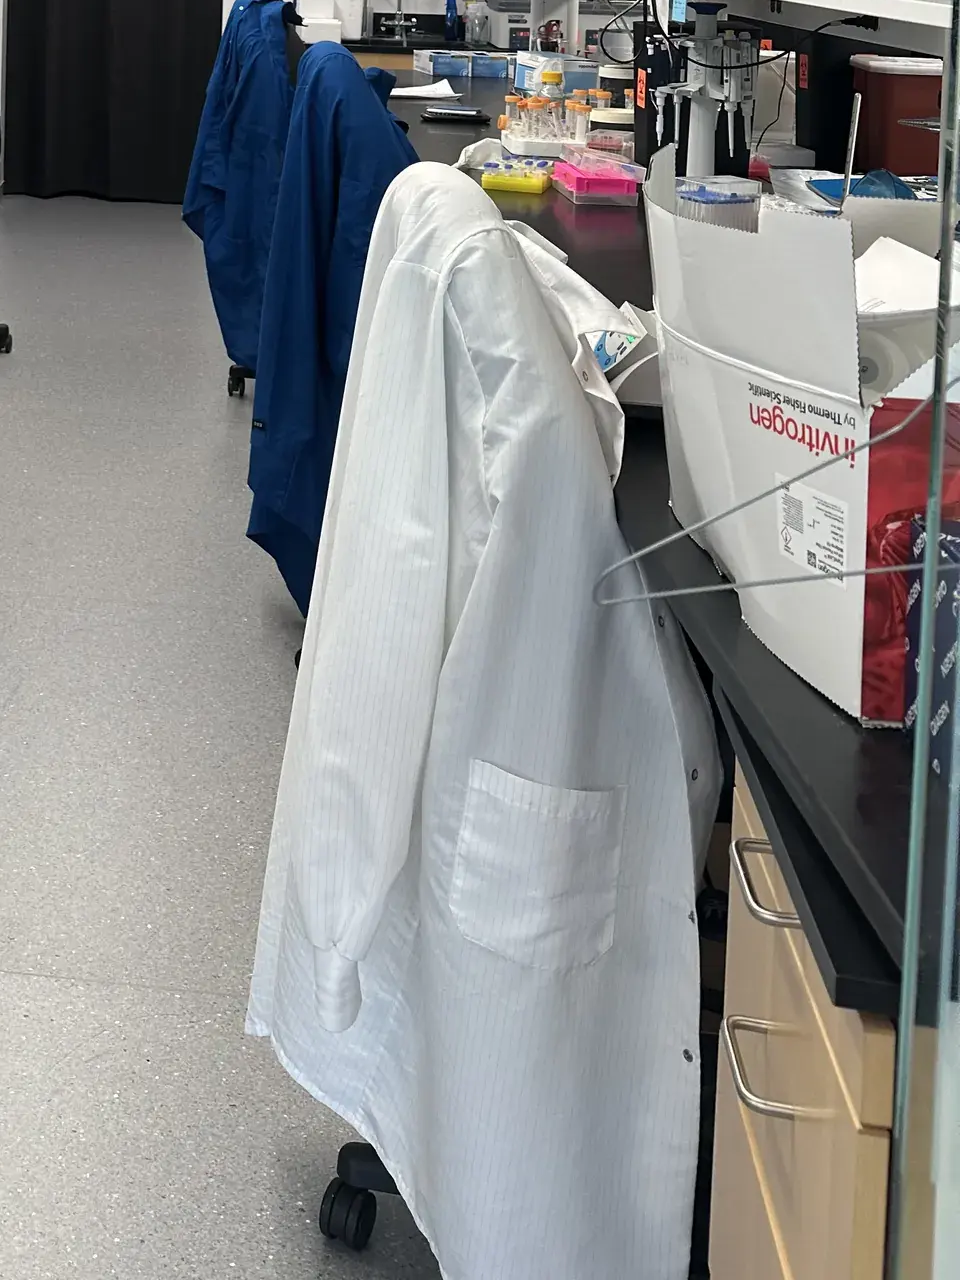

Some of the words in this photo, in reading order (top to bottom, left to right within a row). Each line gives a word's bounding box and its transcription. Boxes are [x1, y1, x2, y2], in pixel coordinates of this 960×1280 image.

[747, 381, 782, 405] Scientific
[782, 394, 807, 414] Fisher
[807, 403, 843, 426] Thermo
[843, 412, 856, 431] by
[749, 402, 856, 469] invitrogen
